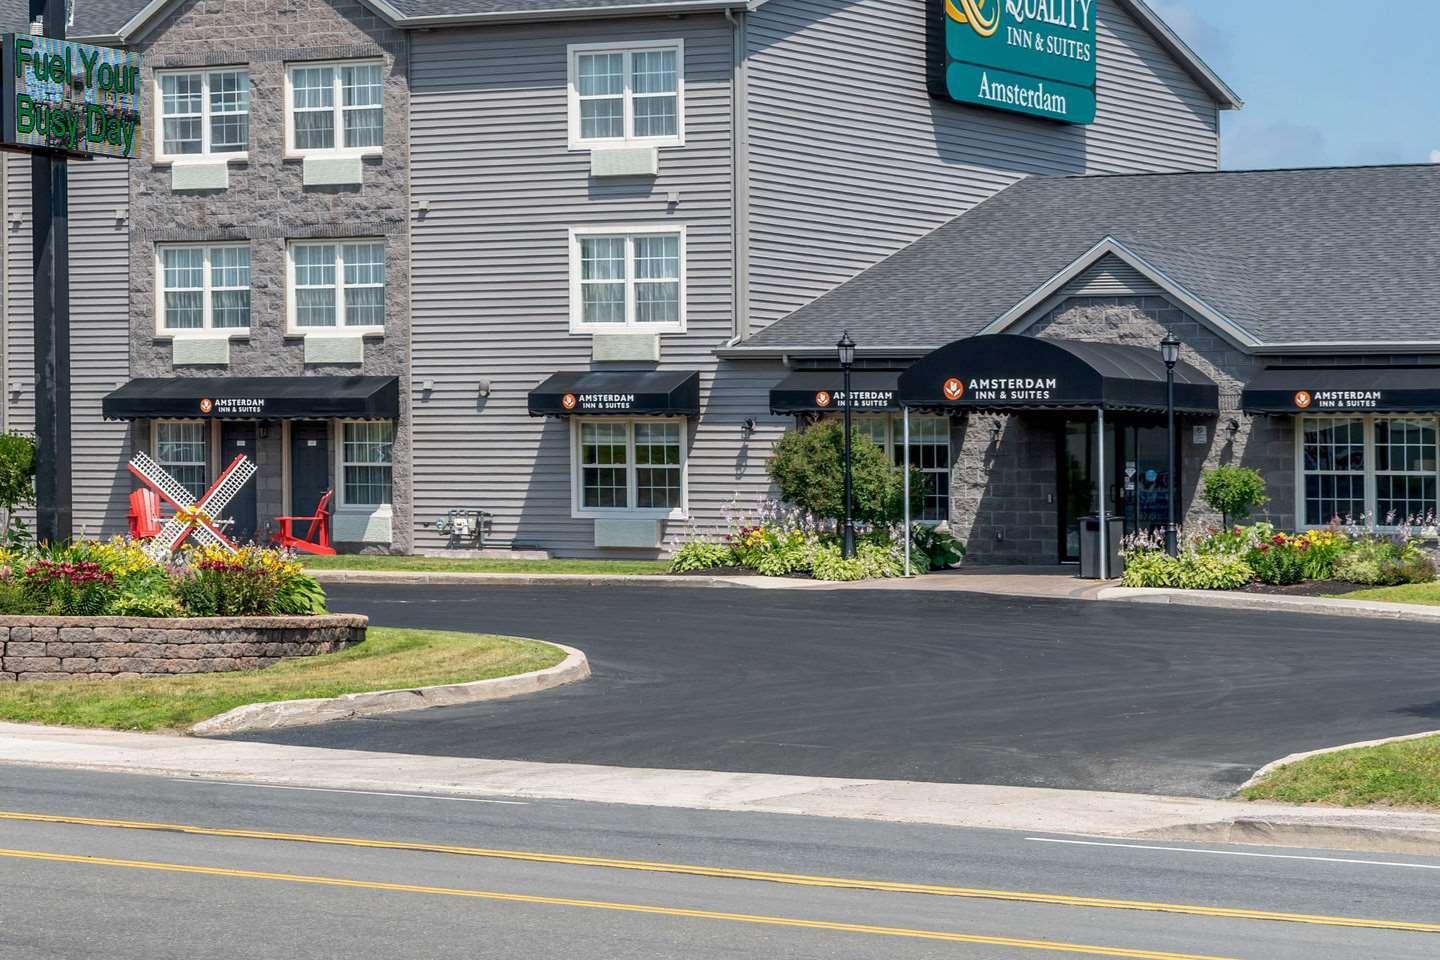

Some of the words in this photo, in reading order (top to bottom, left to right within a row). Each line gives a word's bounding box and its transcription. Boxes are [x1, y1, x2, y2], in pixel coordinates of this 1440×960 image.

[1007, 26, 1033, 49] INN
[1035, 34, 1044, 51] &
[1047, 36, 1091, 62] SUITES
[15, 39, 72, 86] Fuel
[79, 48, 140, 96] Your
[977, 71, 1067, 114] Amsterdam
[16, 93, 79, 151] Busy
[85, 103, 137, 158] Day
[968, 378, 1057, 390] AMSTERDAM
[578, 394, 635, 402] AMSTERDAM
[975, 390, 996, 400] INN
[999, 390, 1007, 400] &
[1010, 390, 1050, 400] SUITES
[1314, 391, 1381, 400] AMSTERDAM
[214, 398, 265, 406] AMSTERDAM
